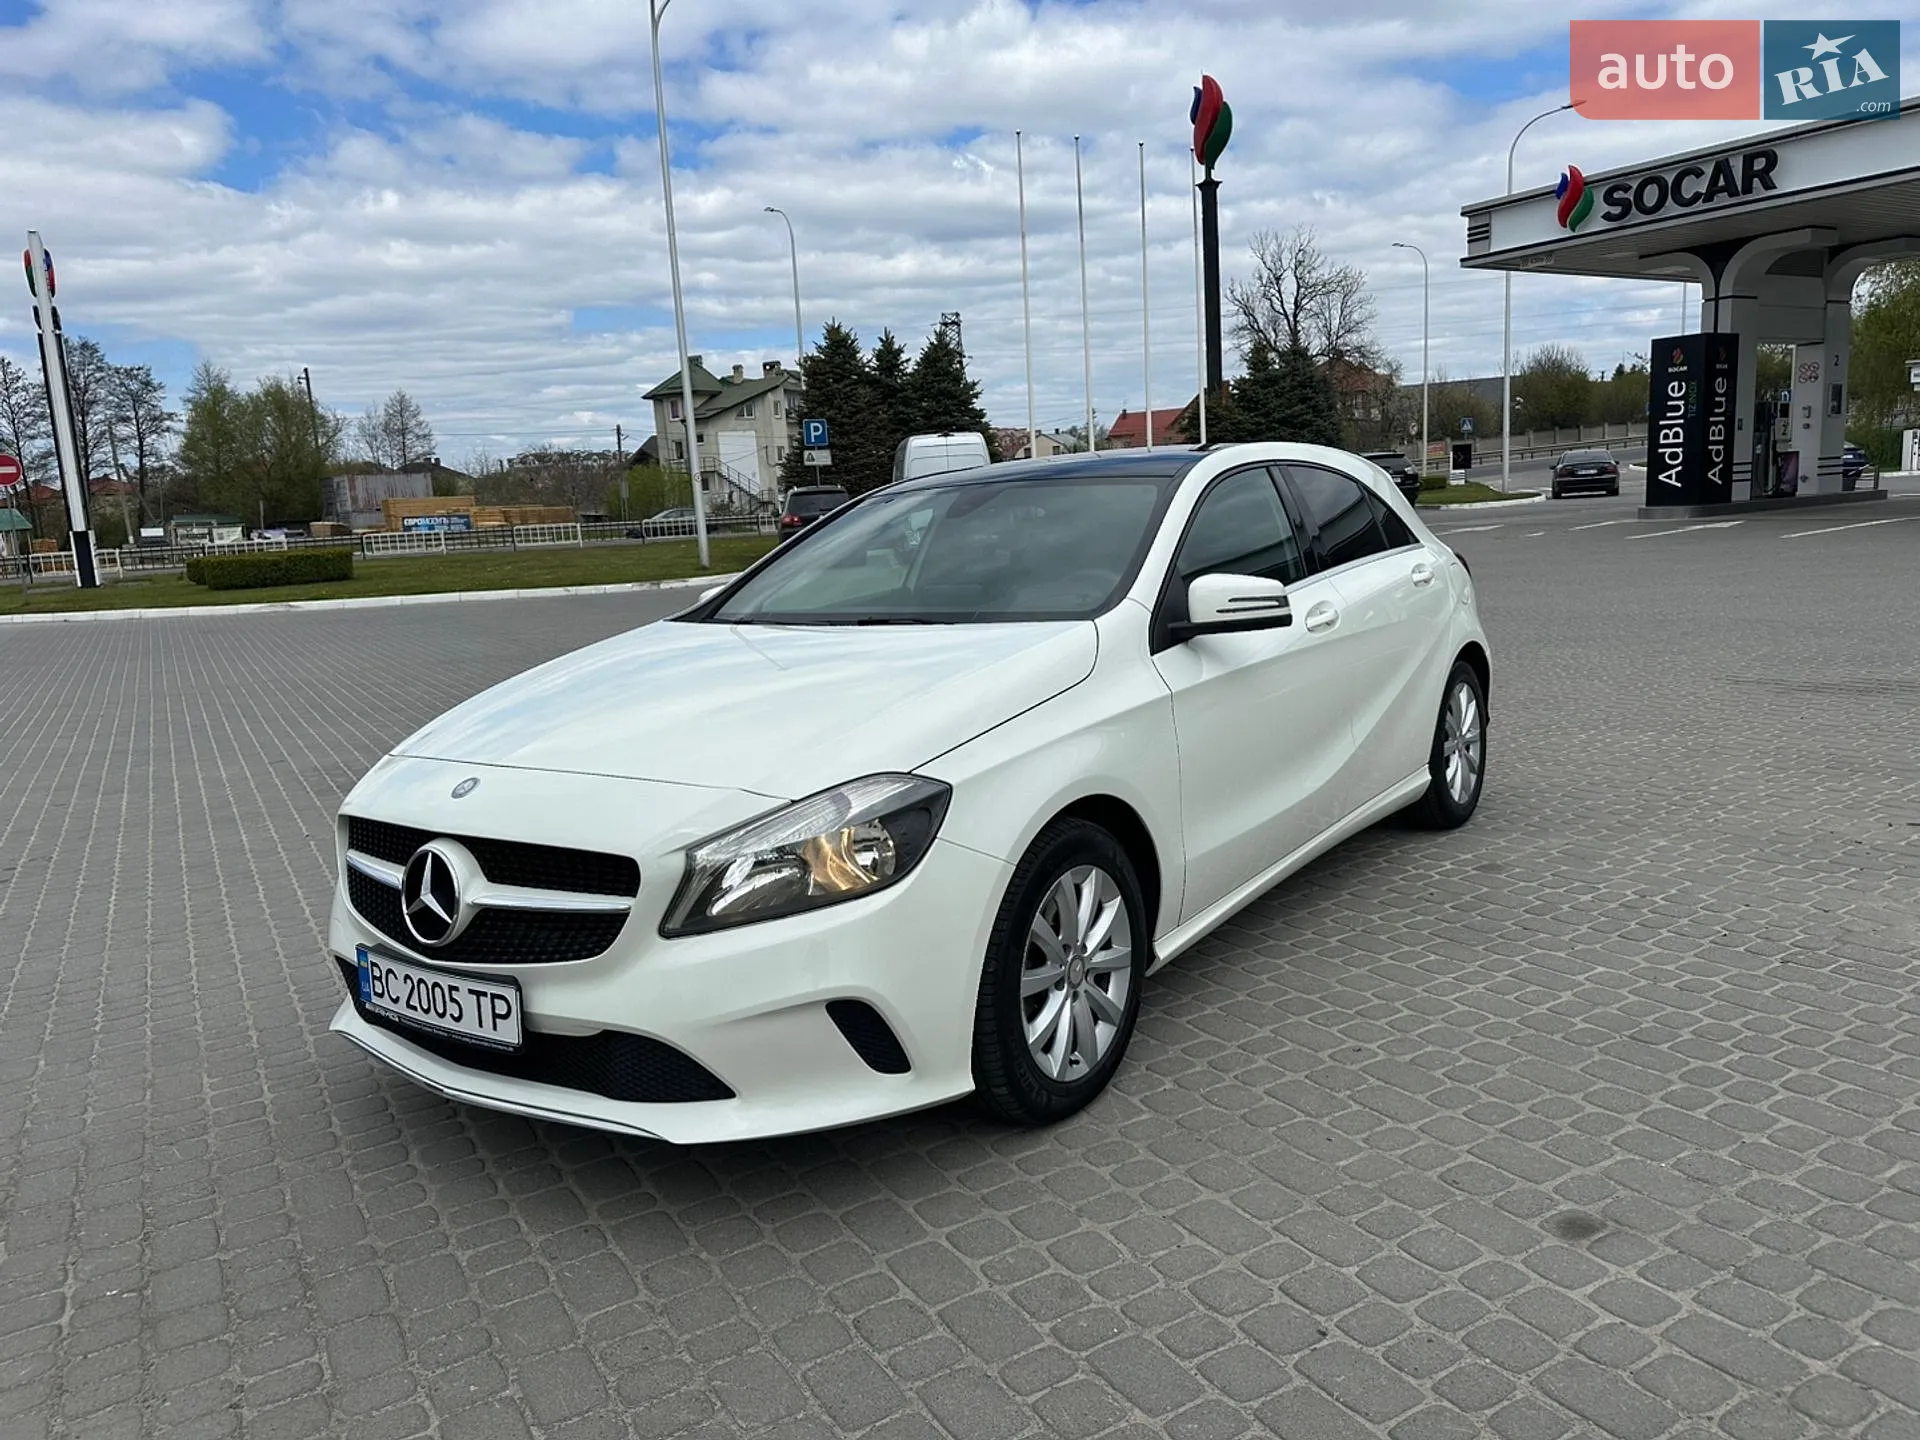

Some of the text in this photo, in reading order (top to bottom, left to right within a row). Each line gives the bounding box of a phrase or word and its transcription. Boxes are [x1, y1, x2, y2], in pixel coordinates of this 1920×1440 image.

[1601, 148, 1779, 223] SOCAR
[1833, 354, 1840, 366] 2
[810, 422, 823, 443] P
[1658, 380, 1687, 488] AdBlue
[1707, 376, 1727, 485] AdBlue
[403, 973, 464, 1024] 2005
[467, 987, 512, 1032] TP
